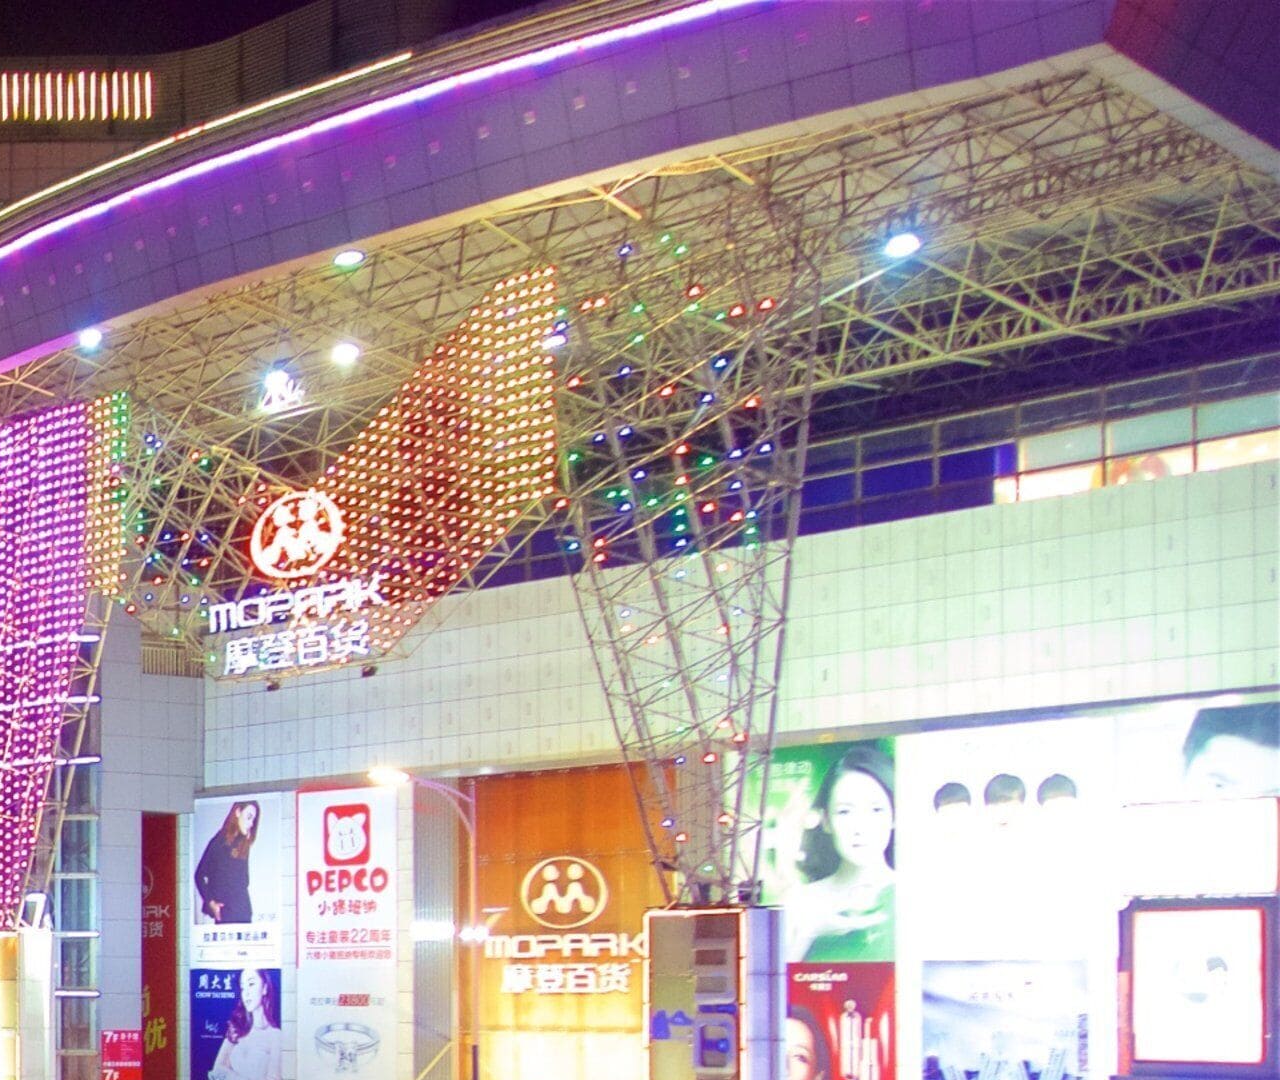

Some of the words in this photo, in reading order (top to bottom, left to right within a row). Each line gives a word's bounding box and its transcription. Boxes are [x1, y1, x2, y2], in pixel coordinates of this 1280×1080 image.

[208, 571, 386, 633] MOPARK
[223, 619, 370, 676] 摩登百货
[306, 867, 388, 896] PEPCO
[485, 932, 647, 959] MOPARK
[198, 973, 233, 991] 周大生
[500, 962, 632, 994] 摩登百货
